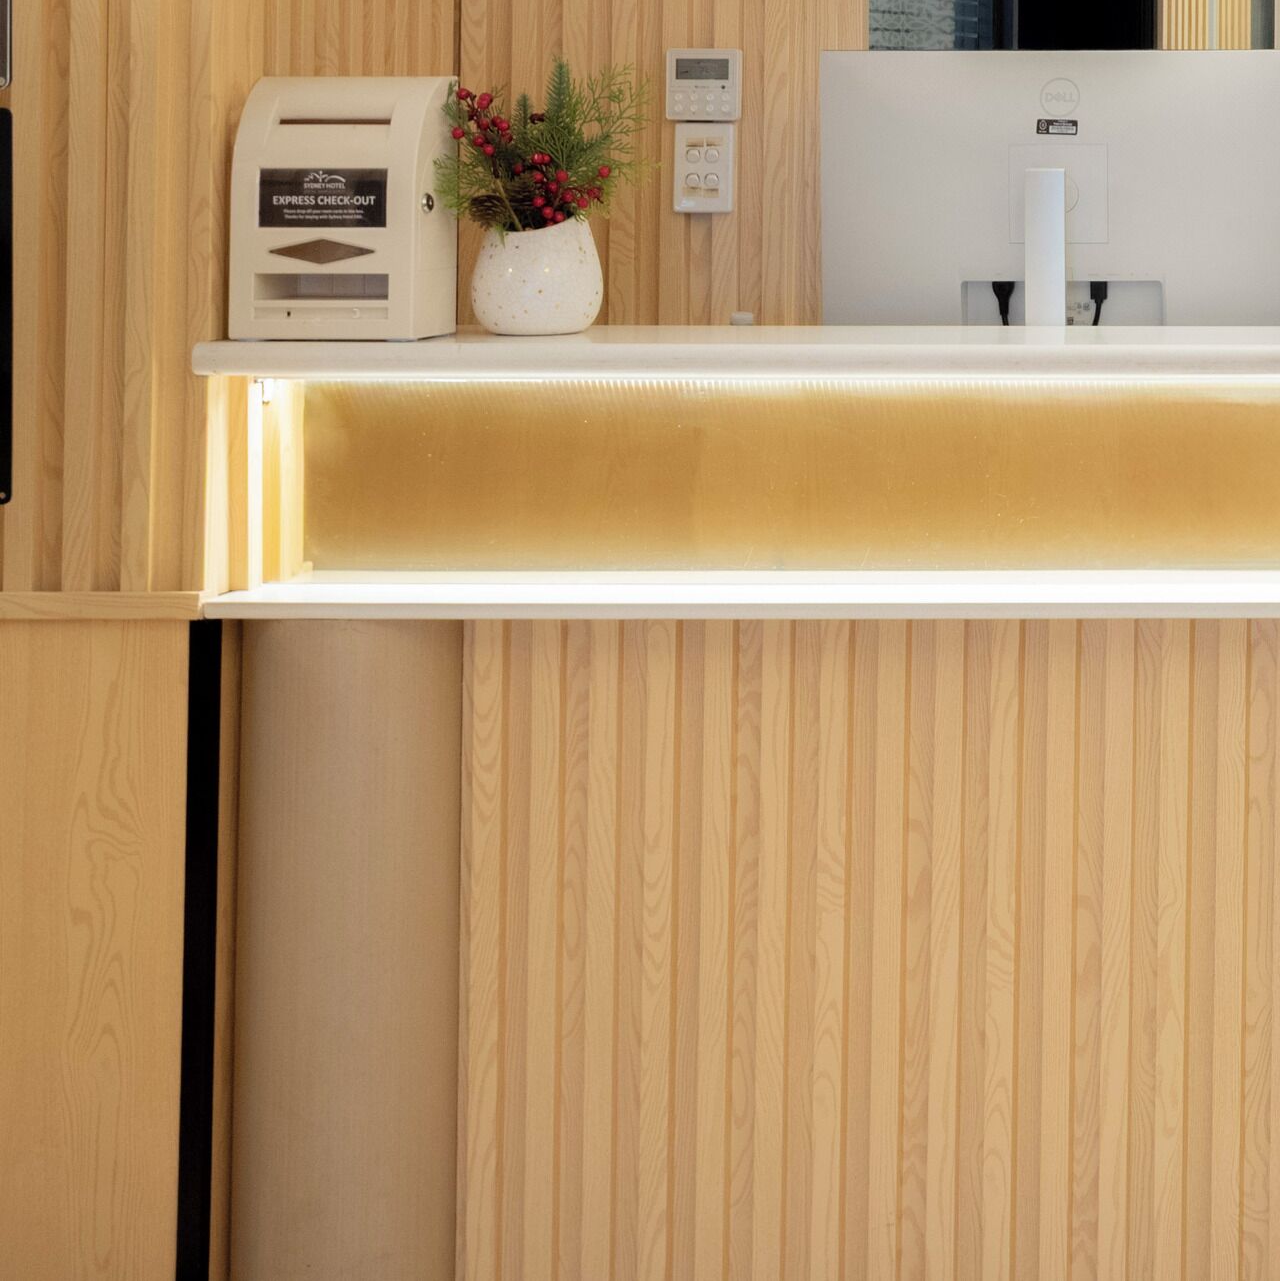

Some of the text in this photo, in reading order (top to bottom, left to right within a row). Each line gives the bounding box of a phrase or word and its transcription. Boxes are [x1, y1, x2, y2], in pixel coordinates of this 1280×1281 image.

[1045, 92, 1075, 103] DELL
[272, 195, 376, 206] EXPRESS CHECK-OUT
